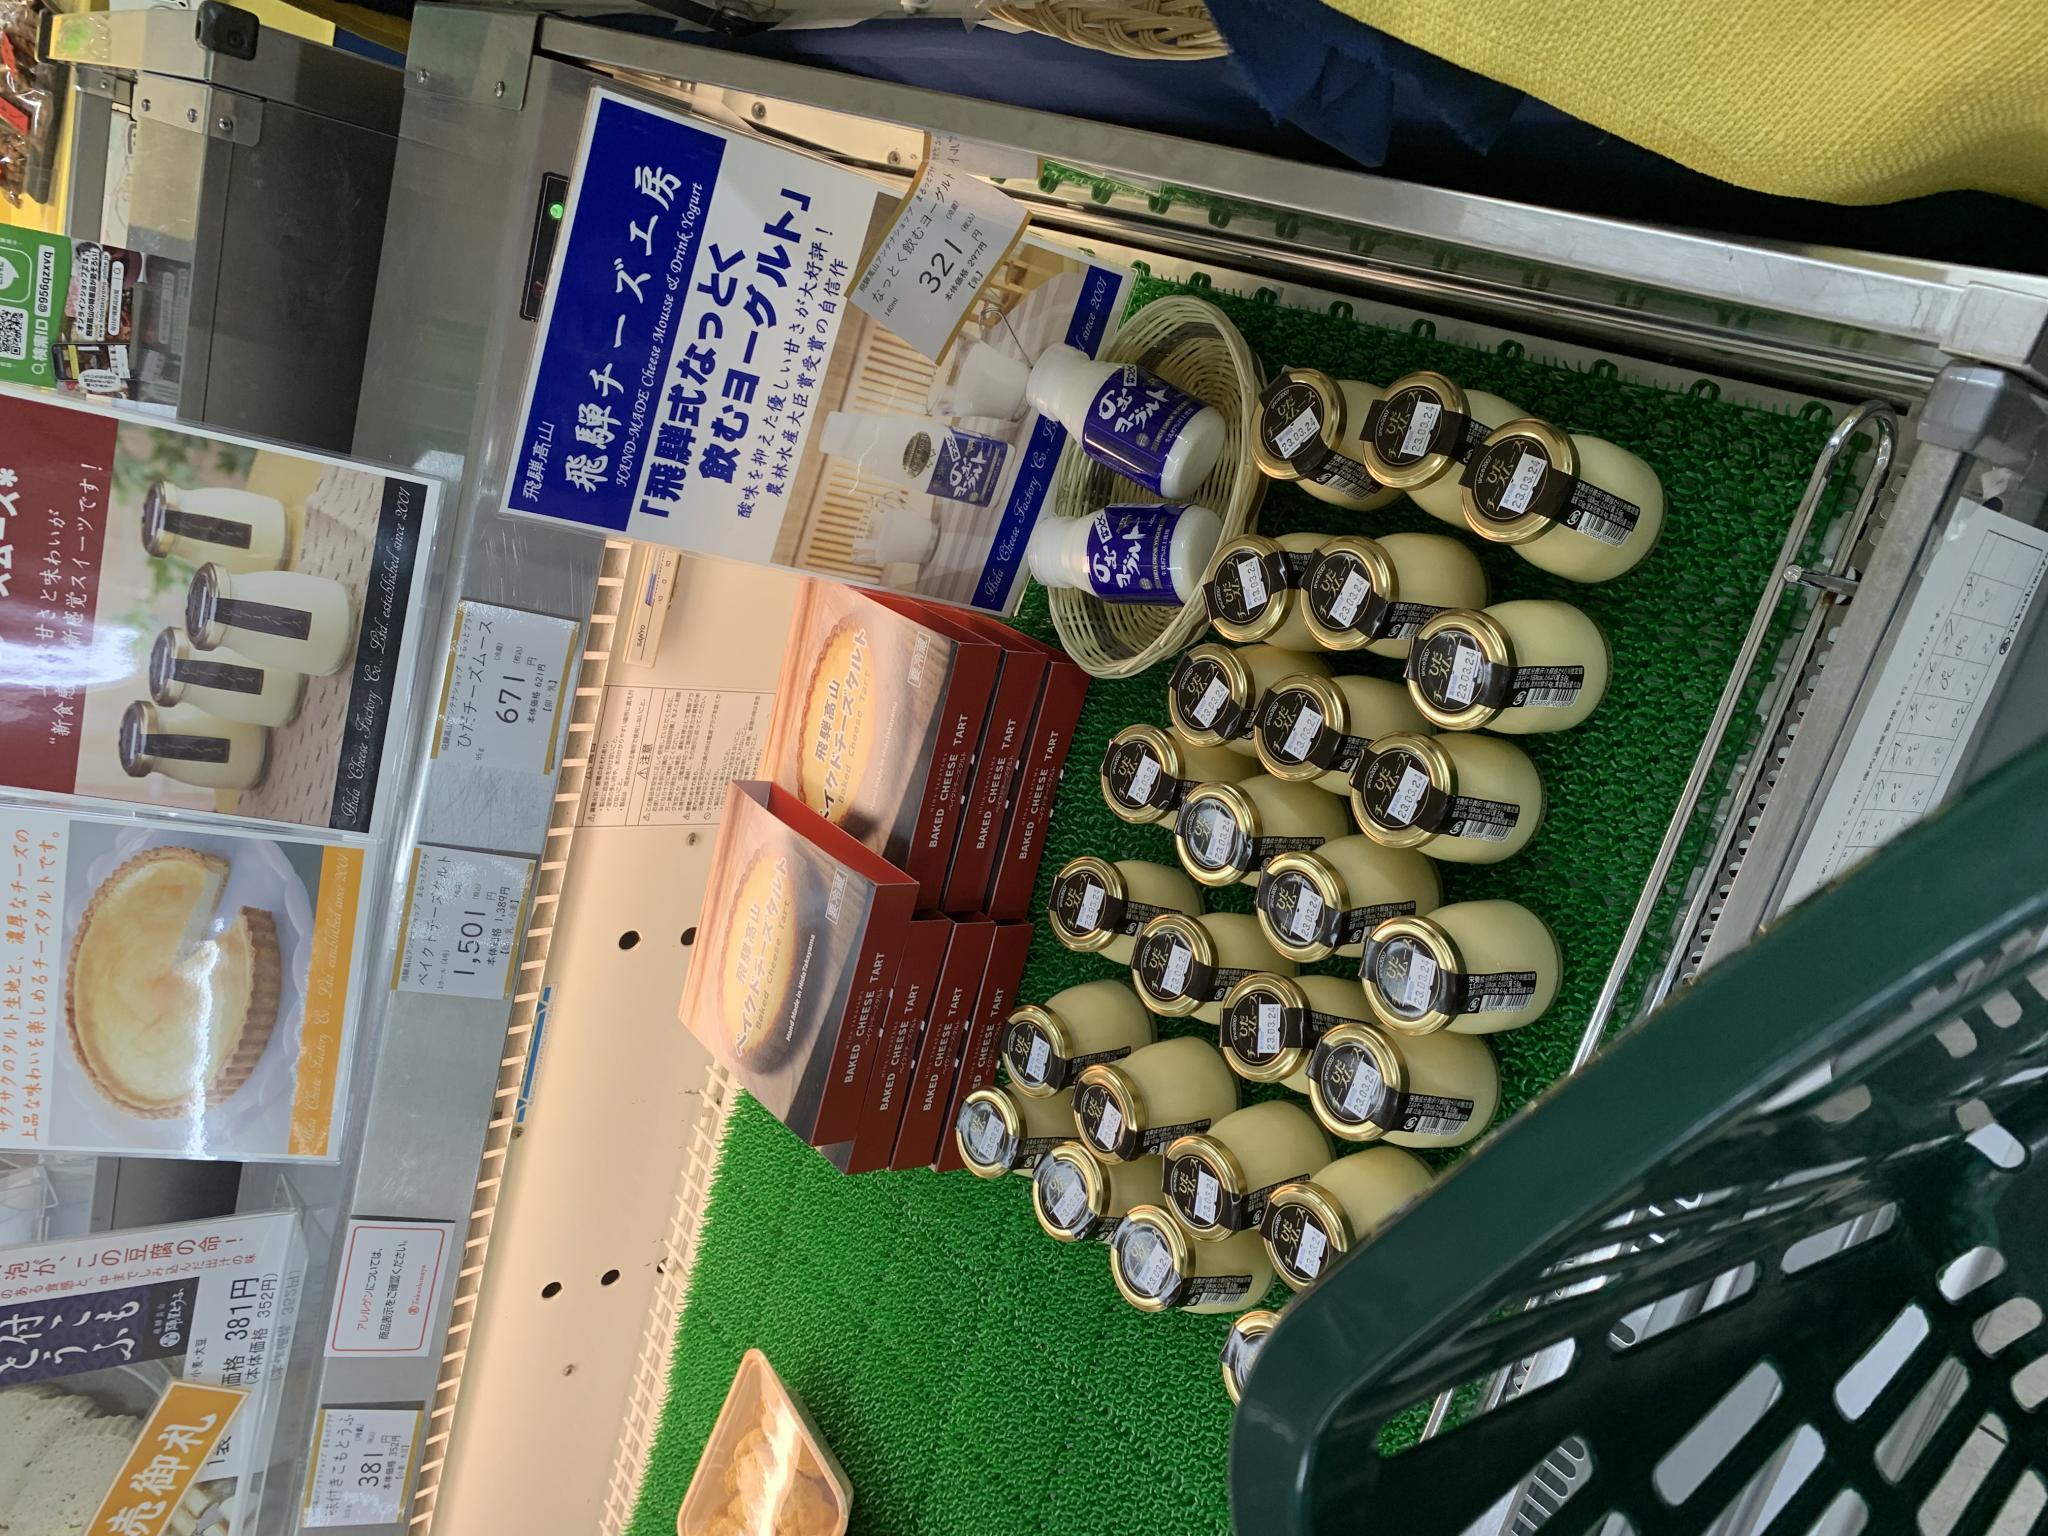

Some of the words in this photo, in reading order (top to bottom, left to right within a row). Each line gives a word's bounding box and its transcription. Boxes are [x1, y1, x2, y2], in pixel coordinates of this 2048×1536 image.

[679, 182, 706, 229] Yogurt
[667, 231, 693, 274] Drink
[870, 172, 955, 303] なっとく飲むヨーグルト
[971, 228, 983, 240] 円
[37, 251, 53, 313] @956qzxvq
[918, 238, 963, 294] 321
[945, 268, 970, 302] 本体価格
[967, 240, 988, 267] 297円
[1089, 275, 1108, 311] 2001
[564, 165, 682, 492] 飛騨チーズ工房
[651, 292, 676, 342] Mousse
[699, 187, 811, 483] 飲むヨーグルト」
[639, 241, 746, 520] 「飛騨式なっとく
[640, 344, 664, 388] Cheese
[736, 227, 833, 519] 酸味を抑えた優しい甘さが大好評！
[765, 257, 849, 497] 農林水産大臣賞受賞の自信作
[1114, 387, 1169, 432] ヨーグルト
[1411, 406, 1434, 452] 23.03.24
[615, 389, 649, 487] HAND-MADE
[1281, 417, 1316, 452] 23.03.24
[522, 421, 555, 502] 飛騨高山
[1486, 458, 1503, 484] ひだ
[1511, 459, 1541, 509] 23.03.24
[394, 485, 411, 521] 2001
[390, 523, 406, 551] since
[1115, 516, 1147, 588] ヨーグルト
[379, 553, 402, 618] established
[1222, 582, 1234, 603] ひだ
[1246, 561, 1262, 603] 23.03.24
[1338, 580, 1365, 621] 23.03.24
[909, 636, 929, 682] 要冷蔵
[1428, 651, 1442, 676] ひだ
[1456, 652, 1476, 700] 23.03.24
[457, 620, 493, 748] ひだチーズムース
[495, 676, 525, 724] 671
[1186, 673, 1202, 693] ひだ
[1200, 684, 1226, 722] 23.03.24
[354, 690, 383, 739] Factory
[815, 679, 841, 762] 飛騨高山
[838, 764, 852, 803] Baked
[848, 710, 863, 757] Cheese
[859, 670, 871, 701] Tart
[1294, 714, 1318, 755] 23.03.24
[346, 743, 369, 780] Cheese
[639, 743, 653, 765] 注意
[928, 808, 945, 848] BAKED
[940, 754, 958, 801] CHEESE
[952, 713, 969, 747] TART
[976, 810, 992, 849] BAKED
[988, 757, 1006, 804] CHEESE
[1001, 718, 1017, 750] TART
[1018, 821, 1035, 859] BAKED
[1030, 768, 1049, 814] CHEESE
[1043, 730, 1059, 761] TART
[1135, 762, 1156, 801] 23.03.24
[1375, 766, 1390, 791] ひだ
[1398, 774, 1422, 819] 23.03.24
[1214, 819, 1231, 860] 23.03.24
[827, 873, 846, 919] 要冷蔵
[1301, 895, 1319, 937] 23.03.24
[453, 910, 486, 975] 1,501
[734, 857, 788, 1056] ベイクドチーズタルト
[735, 903, 761, 984] 飛騨高山
[755, 990, 770, 1030] Baked
[766, 937, 782, 984] Cheese
[777, 899, 790, 930] Tart
[797, 934, 816, 990] HidaTakayama
[22, 831, 59, 1142] 上品な味わいを楽しめるチーズタルトです。
[1413, 960, 1431, 1006] 23.03.24
[785, 1021, 796, 1042] Hand
[789, 999, 801, 1020] Made
[844, 1044, 861, 1083] BAKED
[856, 991, 875, 1036] CHEESE
[869, 952, 885, 983] TART
[1239, 1015, 1249, 1037] ひだ
[1266, 1006, 1276, 1050] 23.03.24
[879, 1073, 896, 1111] BAKED
[891, 1021, 909, 1066] CHEESE
[904, 984, 920, 1014] TART
[1353, 1068, 1375, 1114] 23.03.24
[0, 1236, 243, 1280] 泡が、この豆腐の命！
[224, 1277, 260, 1341] 381円
[356, 1248, 382, 1331] アレルゲンについては、
[378, 1240, 408, 1340] 商品表示をご確認ください。
[358, 1453, 383, 1487] 381
